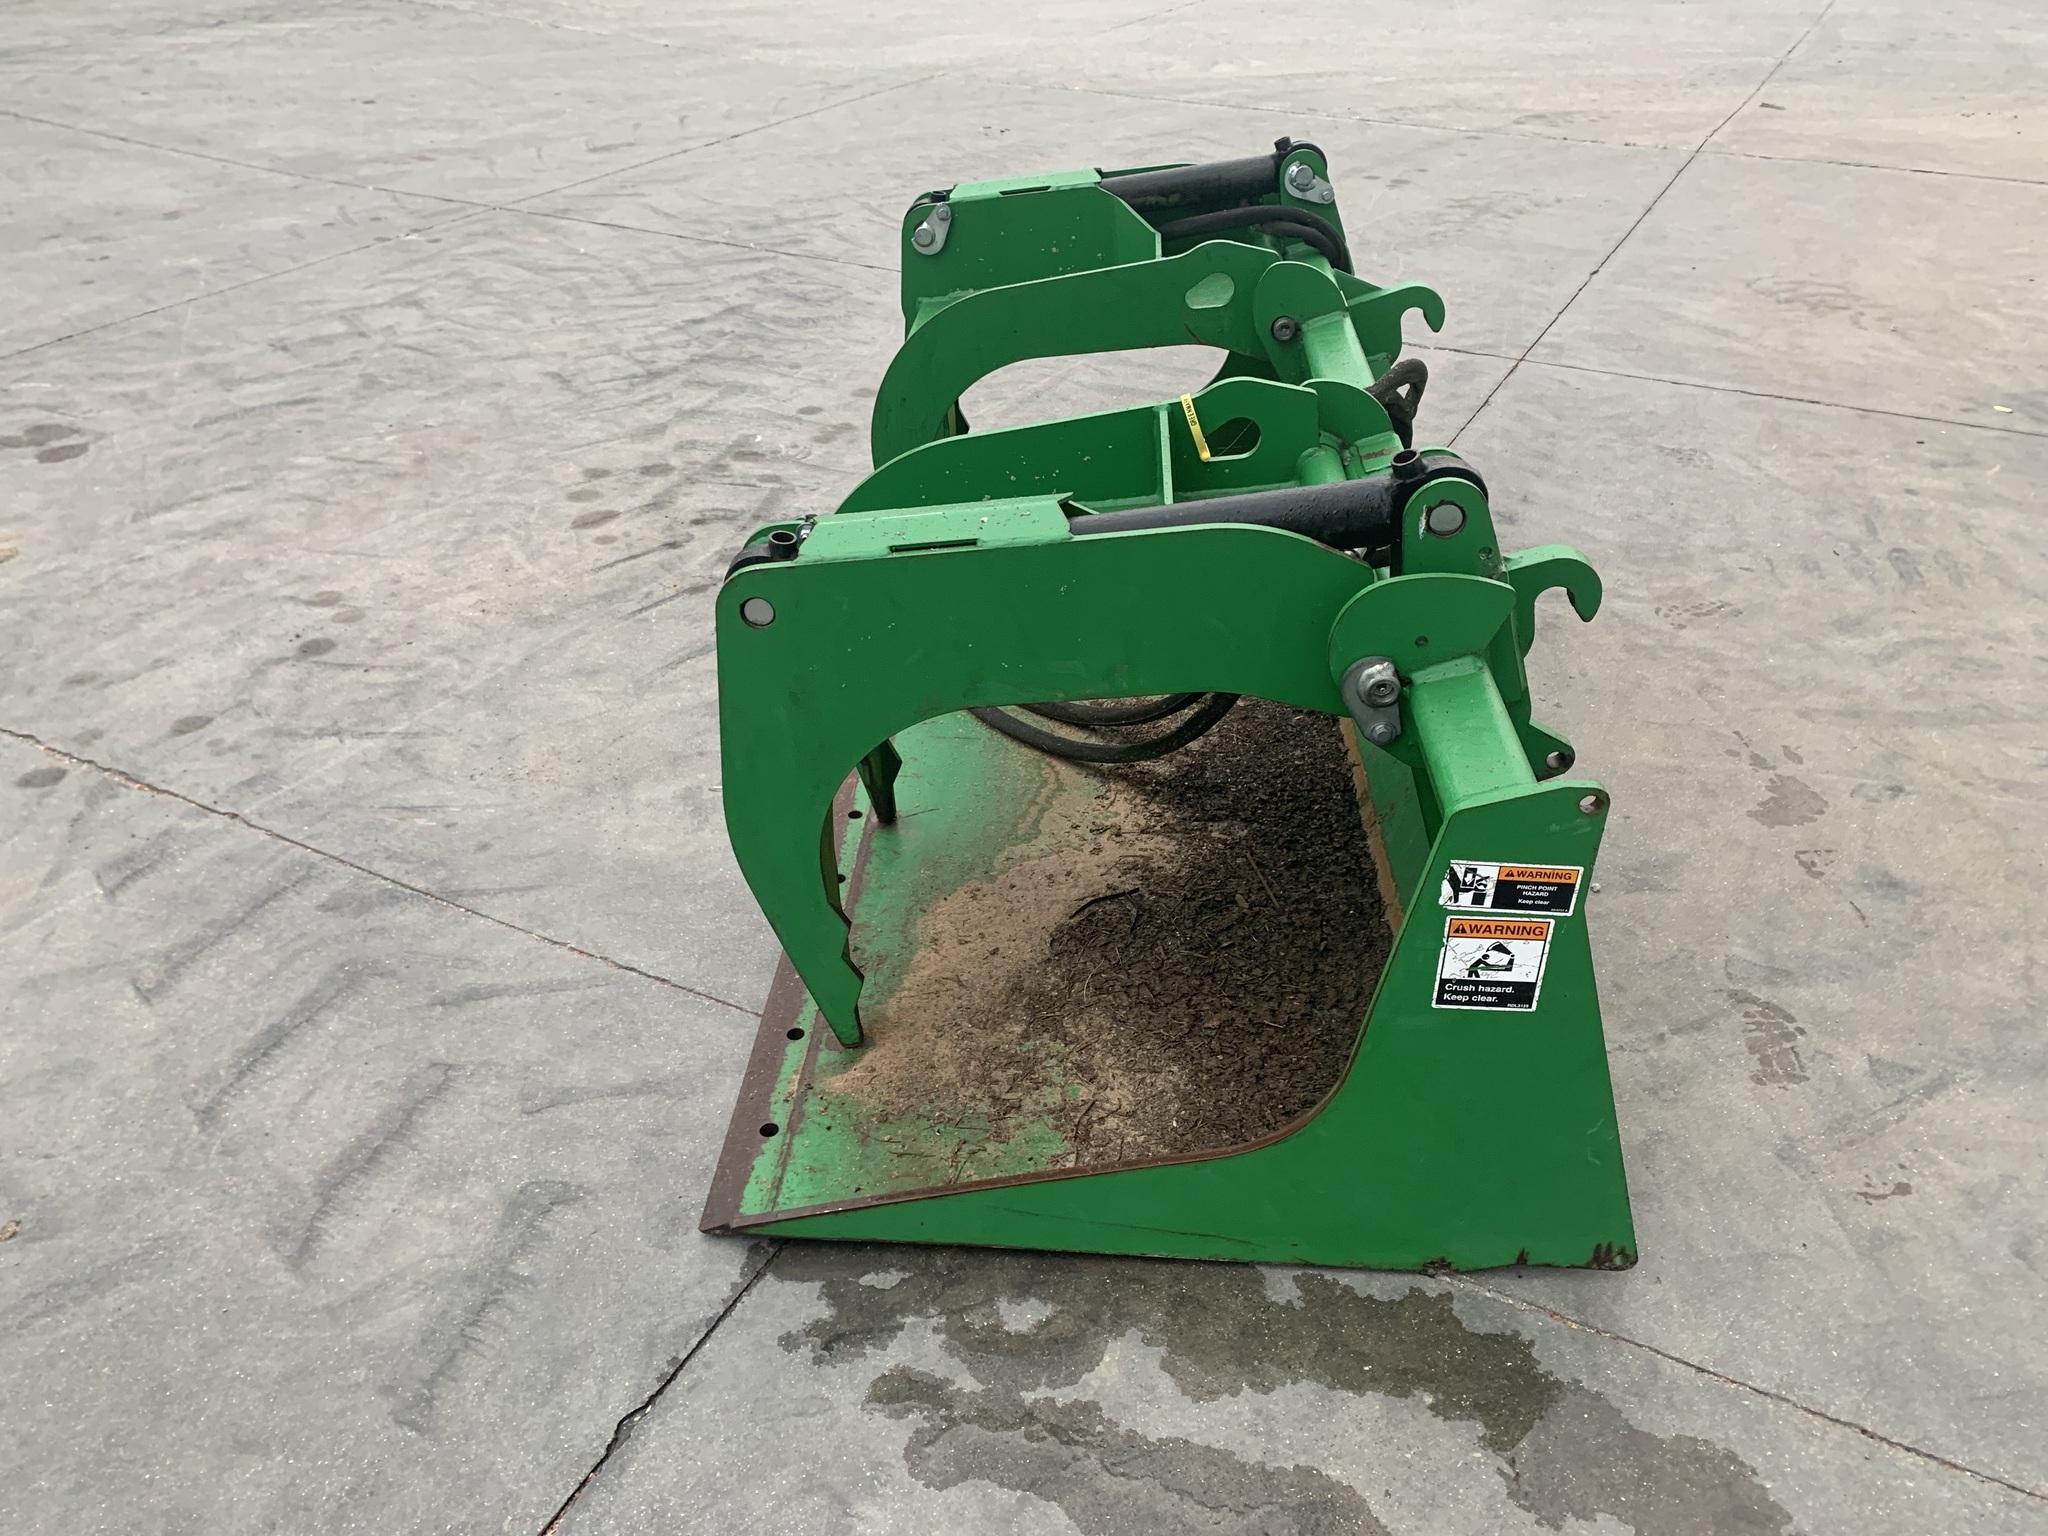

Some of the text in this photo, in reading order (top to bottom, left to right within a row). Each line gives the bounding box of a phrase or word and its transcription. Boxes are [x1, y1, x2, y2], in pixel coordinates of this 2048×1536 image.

[1516, 870, 1572, 880] WARNING
[1468, 923, 1545, 936] WARNING
[1444, 983, 1515, 993] Crush hazard.
[1443, 993, 1499, 1003] Keep clear.
